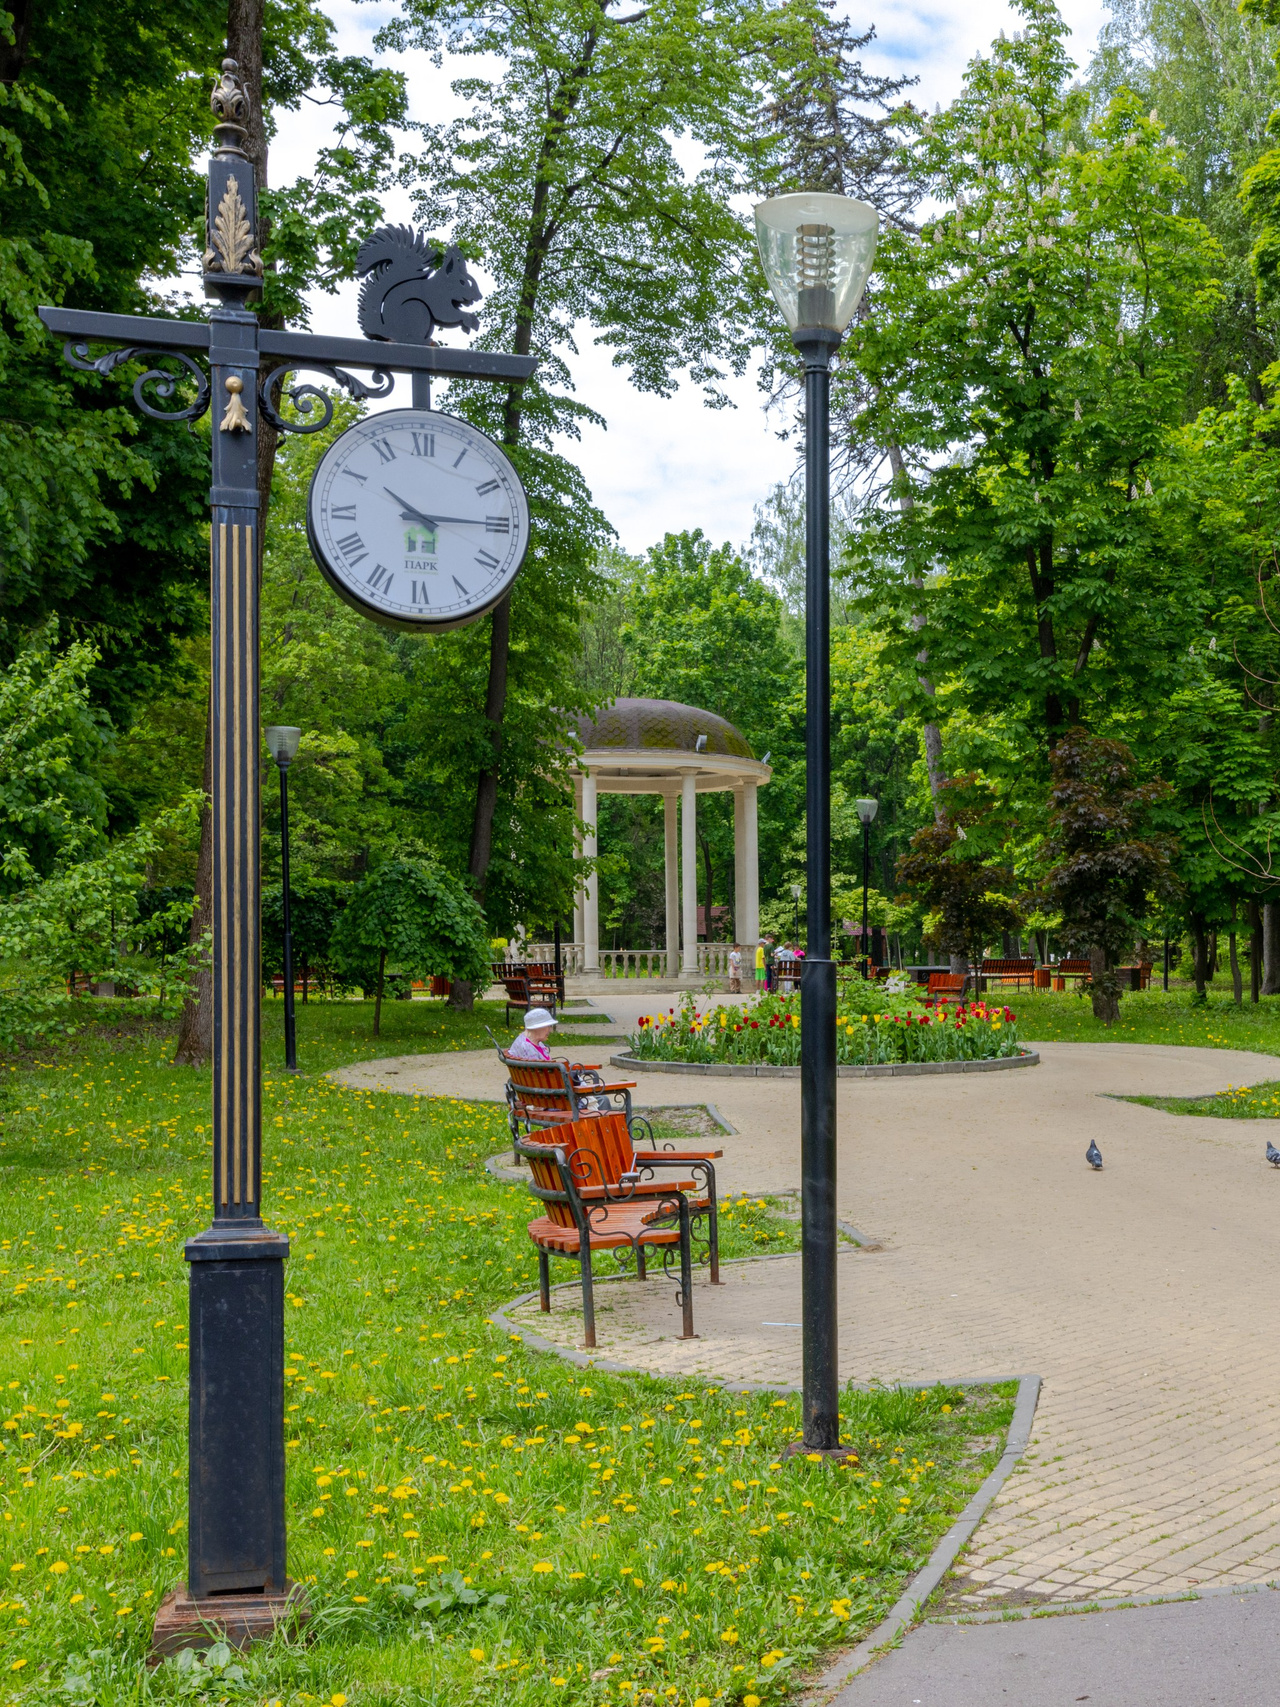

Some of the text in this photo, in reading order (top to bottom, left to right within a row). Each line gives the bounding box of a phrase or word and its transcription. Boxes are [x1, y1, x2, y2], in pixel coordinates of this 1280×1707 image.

[371, 437, 397, 465] XI
[411, 432, 435, 457] XII
[452, 448, 469, 468] I
[341, 466, 368, 486] X
[475, 479, 500, 496] II
[331, 503, 356, 521] IX
[486, 516, 509, 534] III
[336, 532, 369, 568] VIII
[404, 560, 438, 571] ПАРК
[474, 549, 500, 575] IV
[366, 563, 394, 595] VII
[452, 575, 469, 598] V
[411, 580, 430, 605] VI
